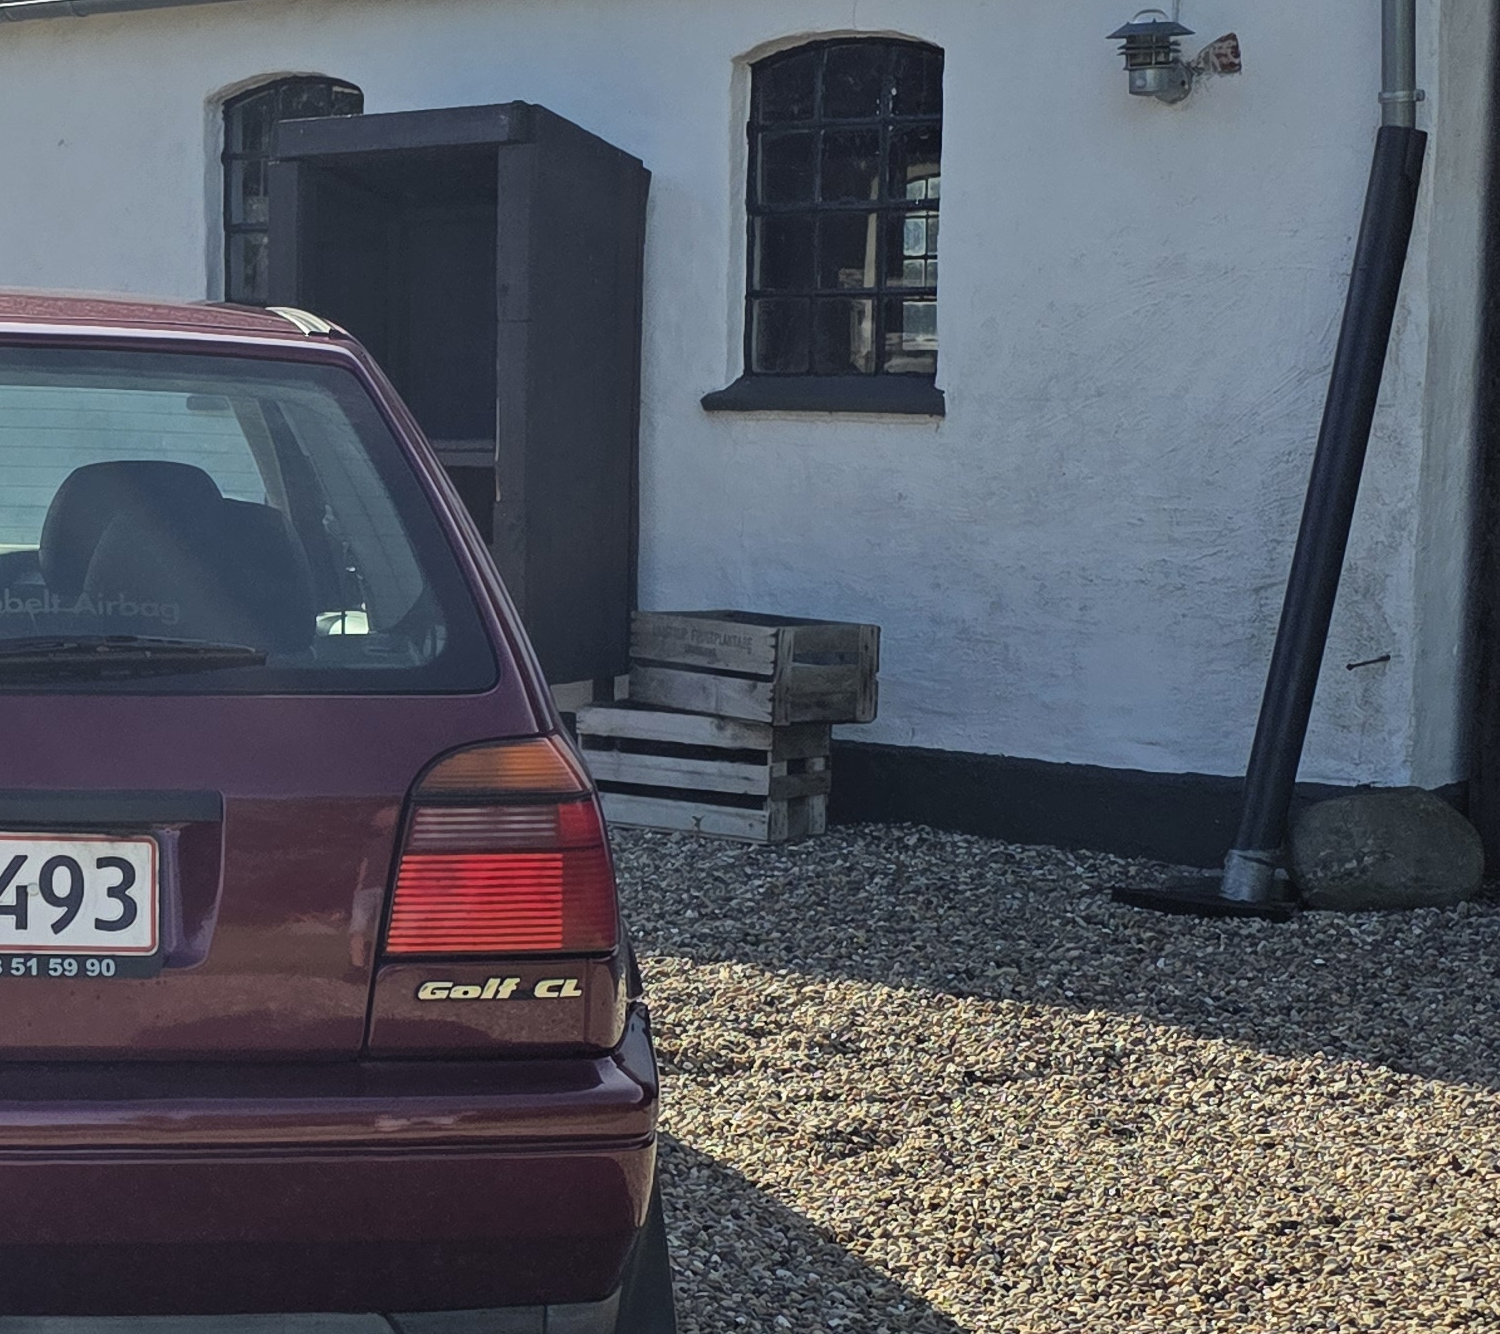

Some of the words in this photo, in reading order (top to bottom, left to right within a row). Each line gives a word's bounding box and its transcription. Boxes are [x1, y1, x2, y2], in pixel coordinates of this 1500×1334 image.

[74, 591, 181, 625] Airbag
[10, 957, 38, 976] 51
[48, 958, 79, 977] 59
[85, 958, 116, 977] 90
[417, 977, 521, 1000] Golf
[533, 978, 583, 999] CL
